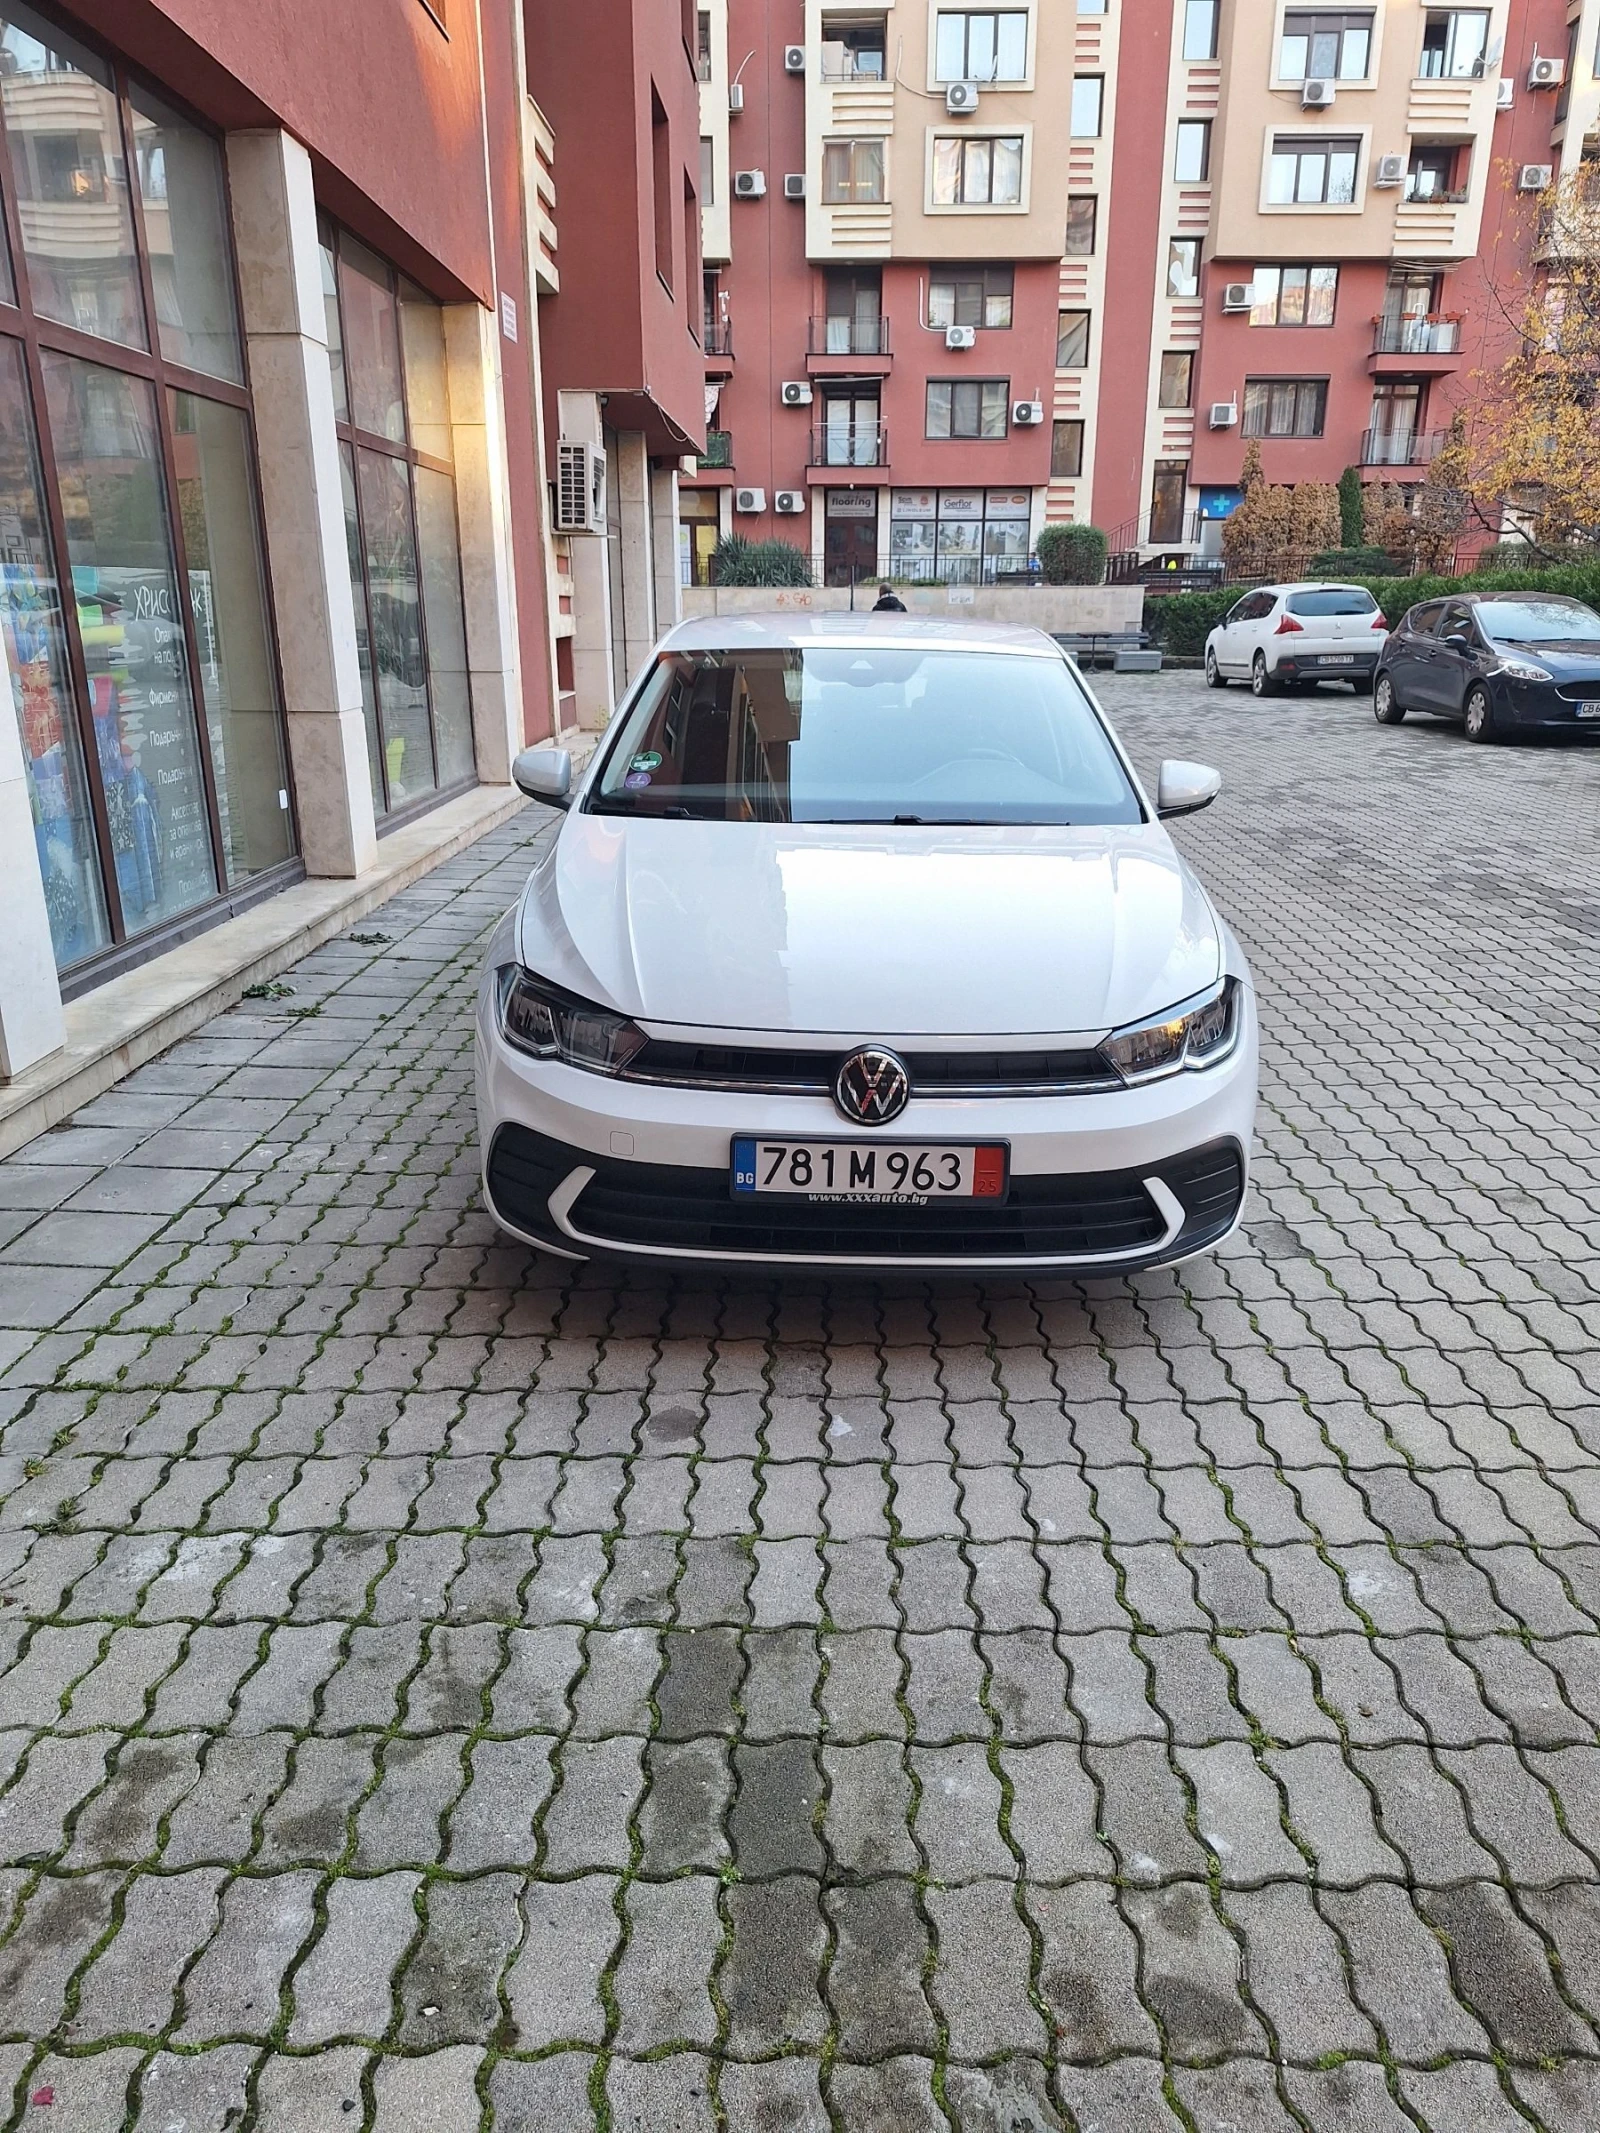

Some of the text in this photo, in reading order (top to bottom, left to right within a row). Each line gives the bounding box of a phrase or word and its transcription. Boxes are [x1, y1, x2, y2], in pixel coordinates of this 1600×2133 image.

[831, 494, 871, 508] flooring
[943, 498, 972, 509] Gerflor
[736, 1172, 754, 1185] BG
[808, 1191, 928, 1206] www.xxxauto.bg
